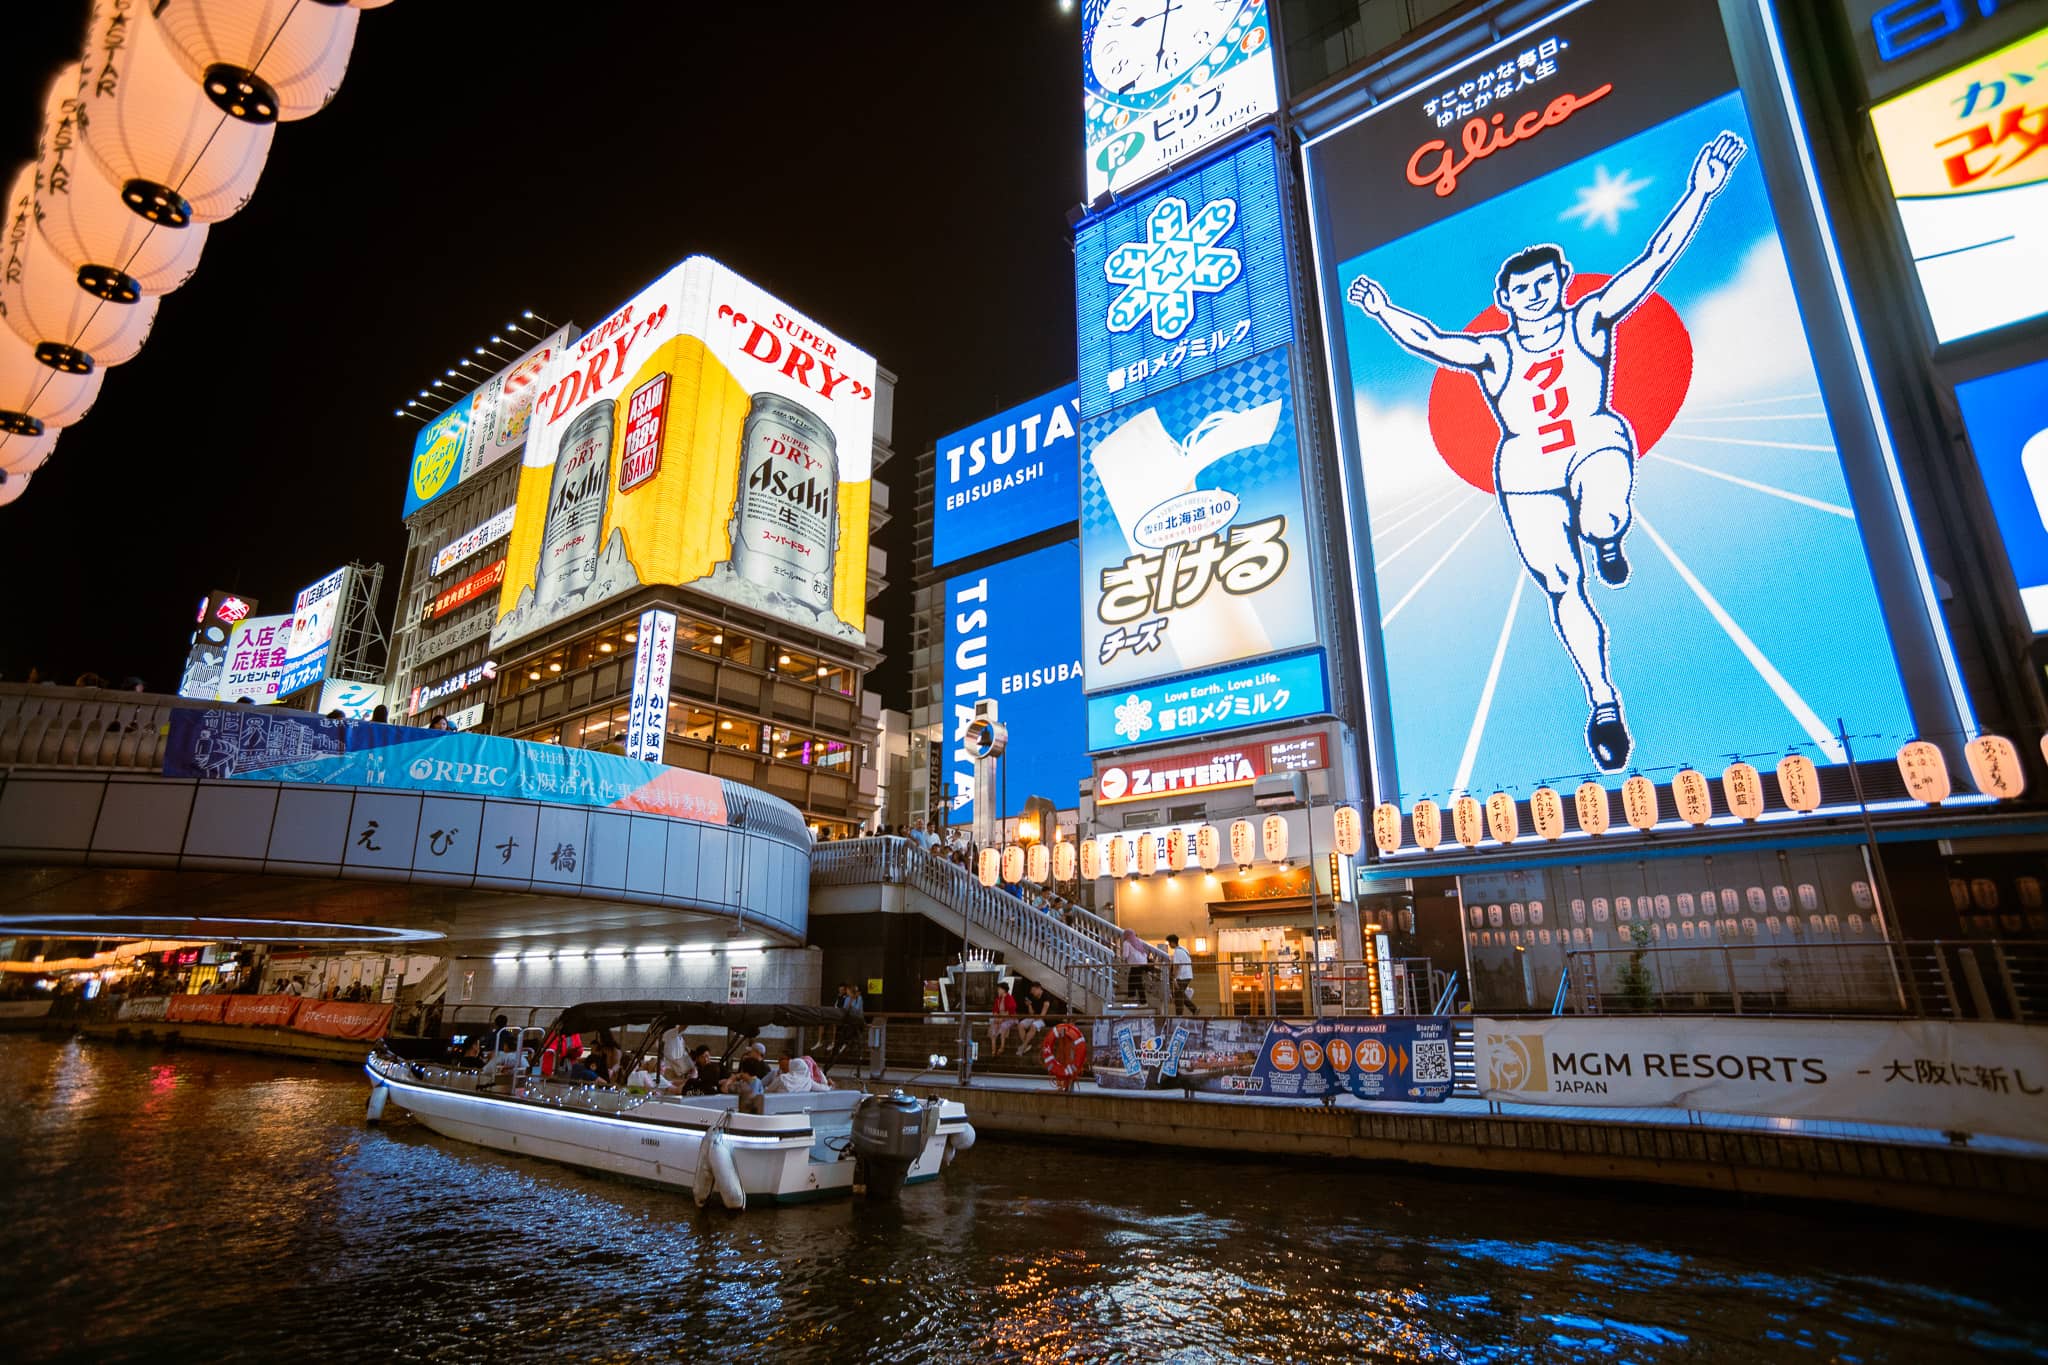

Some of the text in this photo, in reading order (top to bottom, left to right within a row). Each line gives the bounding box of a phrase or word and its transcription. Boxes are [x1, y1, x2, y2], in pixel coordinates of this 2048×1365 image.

[1153, 82, 1225, 143] ピップ
[1437, 60, 1556, 128] ゆたかな人生
[577, 305, 634, 361] SUPER
[772, 313, 838, 361] SUPER
[629, 380, 664, 423] ASAHI
[1523, 349, 1576, 455] グリコ
[626, 417, 659, 458] 1889
[781, 433, 809, 452] SUPER
[946, 397, 1080, 485] TSUTA
[622, 449, 655, 486] OSAKA
[750, 456, 829, 520] Asahi
[946, 461, 1044, 511] EBISUBASHI
[551, 459, 606, 522] Asahi
[778, 505, 799, 528] 生
[762, 530, 812, 557] スーパードライ
[1098, 515, 1289, 625] さける
[236, 625, 276, 649] 入店
[1099, 618, 1169, 666] チーズ
[229, 670, 280, 684] プレゼント中
[231, 646, 287, 672] 応援金
[1164, 672, 1281, 703] Love Earth. Love Life.
[1158, 688, 1291, 732] 雪印メグミルク
[1131, 759, 1255, 795] ZETTERIA
[356, 820, 577, 874] えびす橋
[1359, 1047, 1381, 1065] 20
[1552, 1052, 1632, 1077] MGM
[1643, 1053, 1828, 1085] RESORTS
[1882, 1058, 2045, 1096] 大阪に新し
[1231, 1080, 1263, 1090] PARTY
[1555, 1079, 1608, 1095] JAPAN
